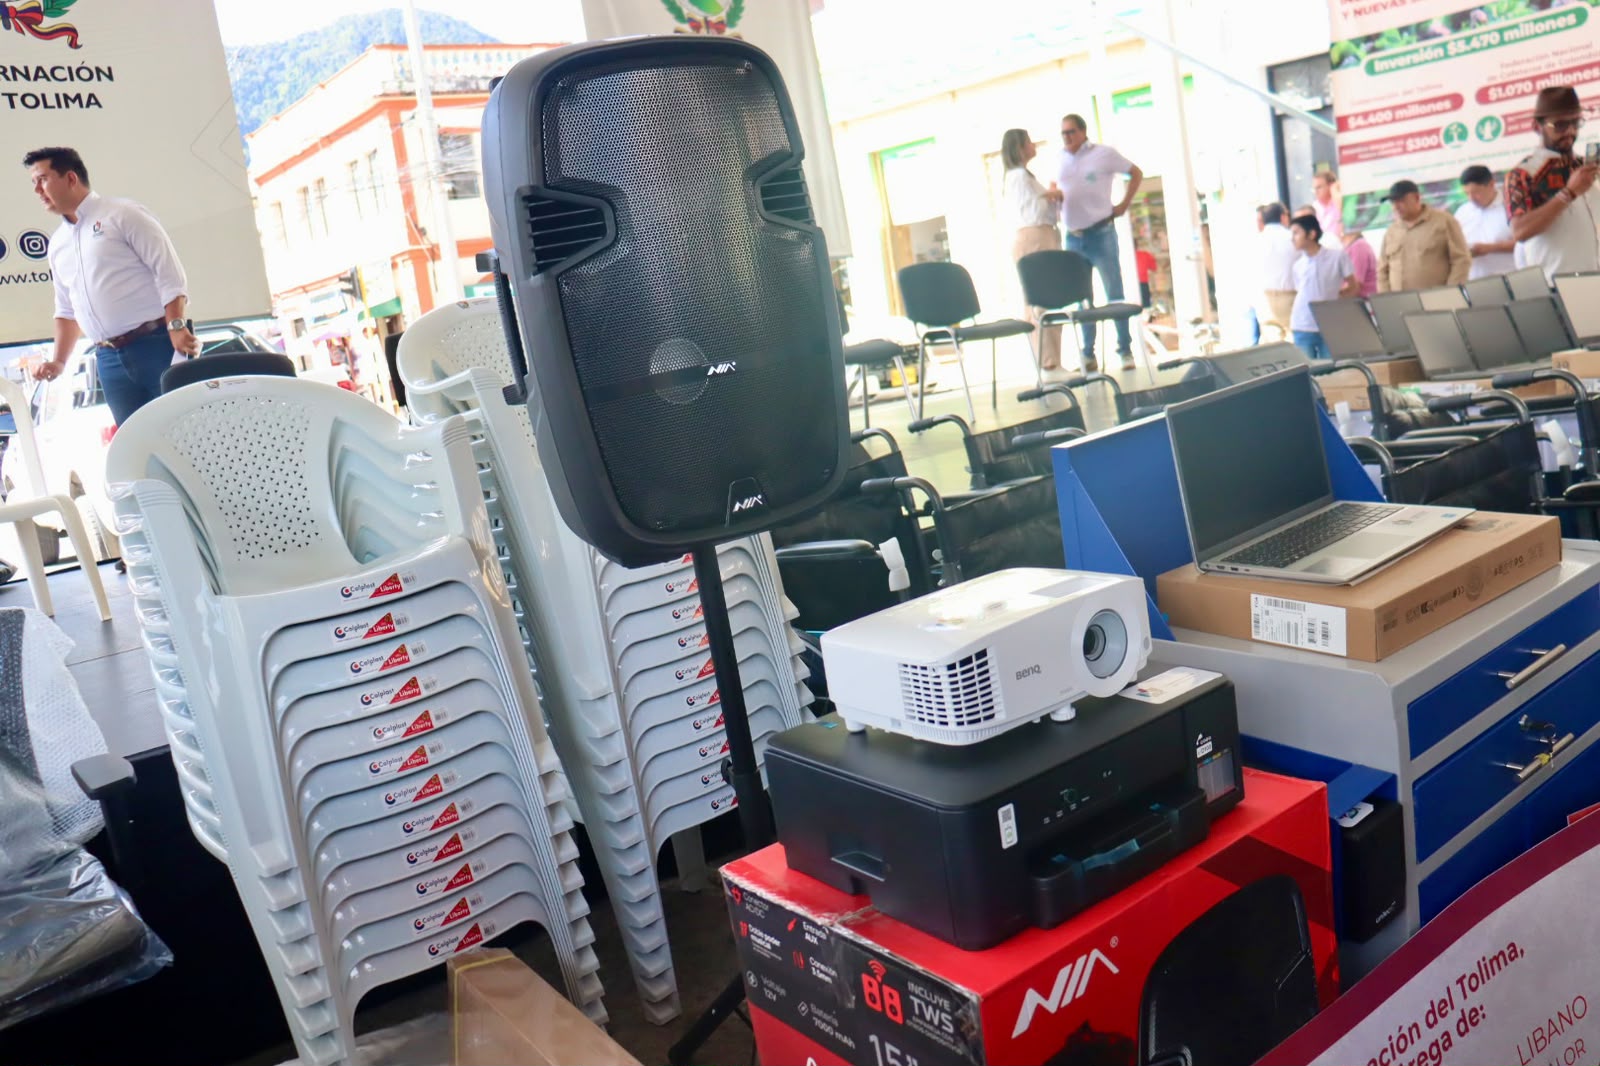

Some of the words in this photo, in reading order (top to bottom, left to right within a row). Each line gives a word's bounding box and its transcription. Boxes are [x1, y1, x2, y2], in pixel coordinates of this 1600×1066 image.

[1374, 46, 1445, 73] Inversión
[1447, 31, 1500, 56] $5.470
[1503, 13, 1577, 42] millones
[1488, 81, 1533, 102] $1.070
[1535, 65, 1600, 89] millones
[1, 92, 103, 109] TOLIMA
[1347, 109, 1393, 130] $4.400
[1394, 99, 1453, 120] millones
[1405, 135, 1439, 152] $300
[380, 583, 401, 592] Liberty
[373, 622, 395, 632] Liberty
[388, 654, 410, 665] Liberty
[1016, 664, 1042, 680] BenQ
[398, 687, 420, 697] Liberty
[411, 721, 432, 731] Liberty
[407, 756, 428, 766] Liberty
[421, 784, 442, 795] Liberty
[802, 921, 828, 940] Entrada
[804, 933, 819, 946] AUX
[1424, 986, 1455, 1030] del
[1456, 942, 1525, 1000] Tolima,
[907, 980, 951, 1012] INCLUYE
[909, 995, 954, 1034] TWS
[1456, 1004, 1487, 1038] de:
[812, 1017, 834, 1036] 7000
[835, 1030, 856, 1050] mAh
[1516, 995, 1588, 1066] LIBANO
